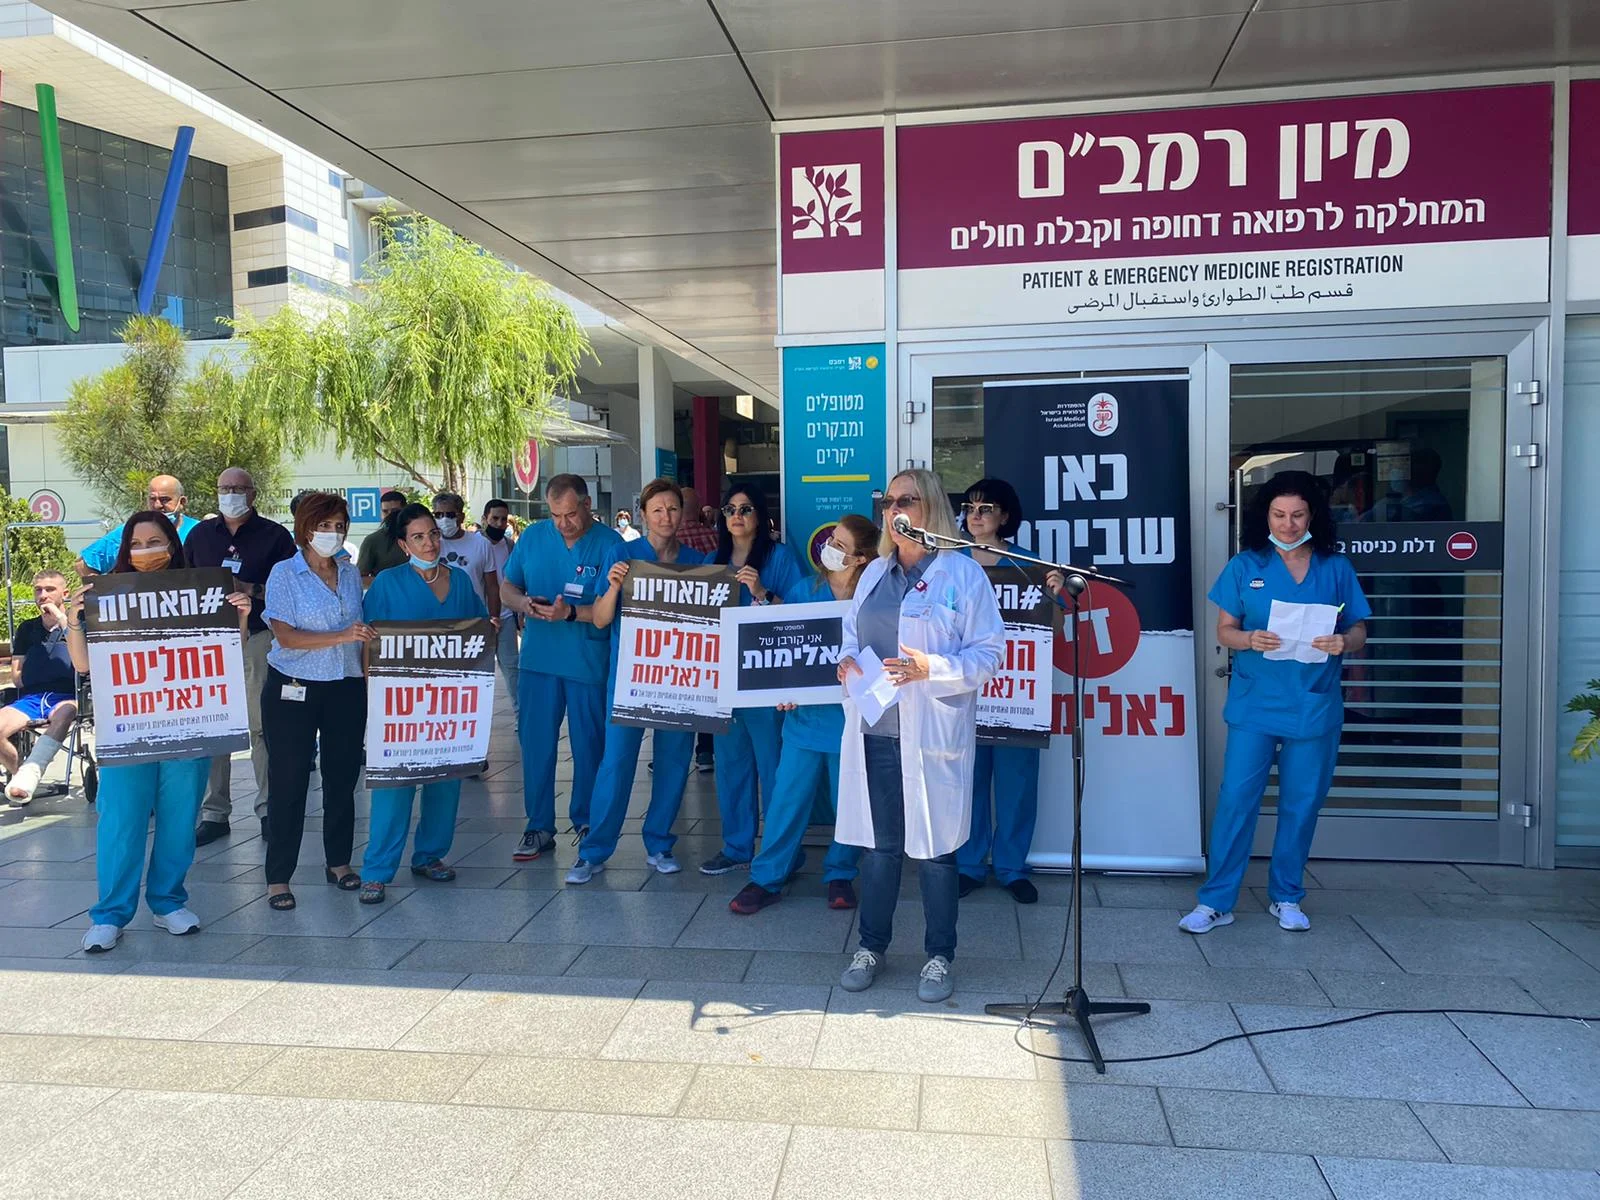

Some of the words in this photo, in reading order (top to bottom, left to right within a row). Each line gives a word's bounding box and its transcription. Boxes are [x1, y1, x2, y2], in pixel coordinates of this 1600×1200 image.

[1279, 118, 1410, 200] מיון
[1132, 213, 1221, 240] דחופה
[1232, 201, 1344, 235] לרפואה
[1355, 197, 1485, 234] המחלקה
[951, 220, 1024, 250] חולים
[1034, 216, 1121, 249] וקבלת
[1023, 270, 1083, 290] PATIENT
[1088, 269, 1098, 287] &
[1104, 264, 1200, 286] EMERGENCY
[1204, 260, 1280, 281] MEDICINE
[1285, 255, 1404, 277] REGISTRATION
[1067, 293, 1119, 314] المرضى
[1202, 286, 1267, 307] الطوارئ
[1308, 283, 1353, 304] قسم
[806, 393, 864, 412] מטופלים
[807, 421, 864, 441] ומבקרים
[816, 448, 855, 467] יקרים
[1044, 454, 1128, 510] כאן
[39, 500, 53, 520] 8
[1351, 540, 1397, 554] כניסה
[1402, 537, 1435, 553] דלת
[632, 576, 730, 607] #האחיות
[98, 586, 224, 623] #האחיות
[379, 635, 485, 659] #האחיות
[634, 627, 720, 663] החליטו
[758, 637, 774, 646] של
[777, 635, 805, 647] קורבן
[807, 634, 822, 644] אני
[110, 644, 224, 686] החליטו
[742, 644, 840, 669] אלימות
[631, 663, 701, 688] לאלימות
[114, 684, 203, 717] לאלימות
[209, 684, 228, 705] די
[384, 683, 478, 716] החליטו
[1020, 678, 1036, 700] די
[1052, 685, 1186, 737] לאלימ
[383, 719, 457, 743] לאלימות
[462, 719, 477, 739] די
